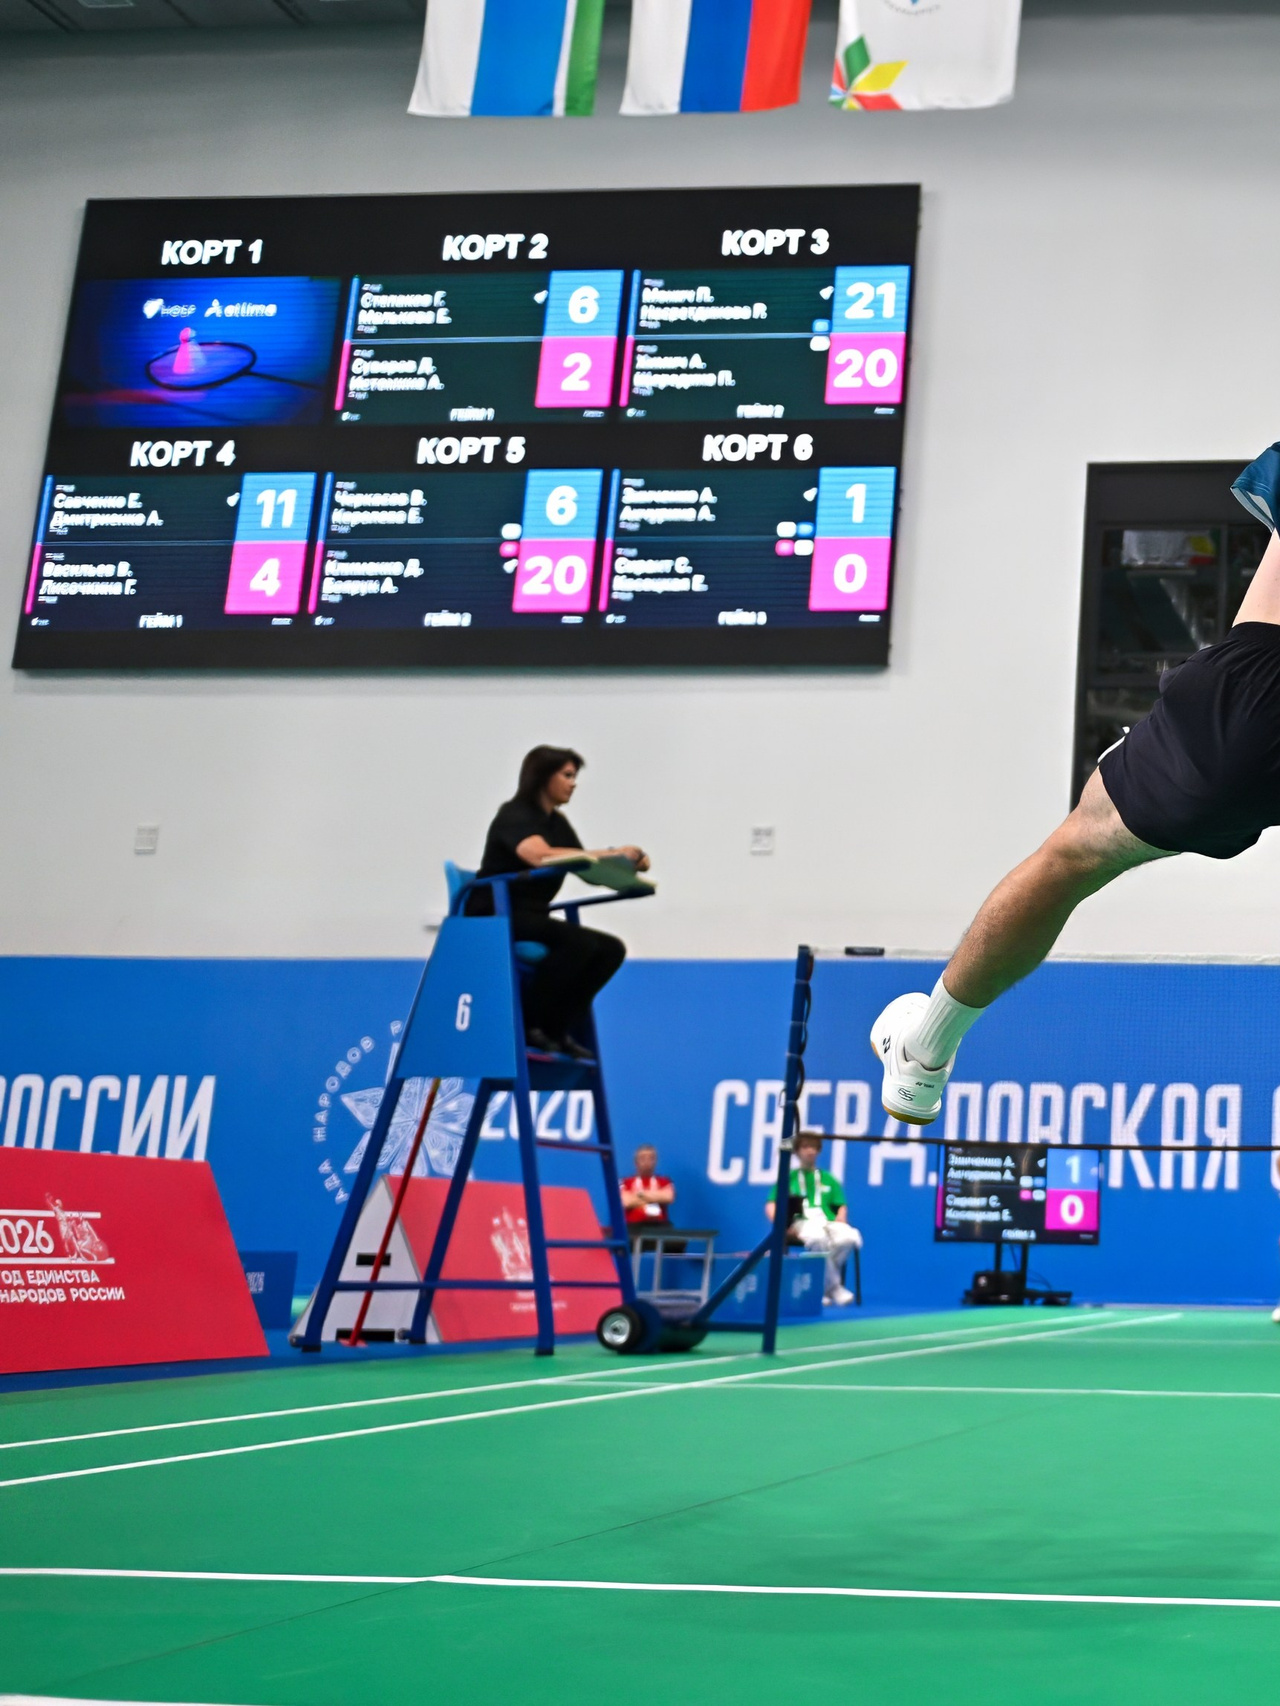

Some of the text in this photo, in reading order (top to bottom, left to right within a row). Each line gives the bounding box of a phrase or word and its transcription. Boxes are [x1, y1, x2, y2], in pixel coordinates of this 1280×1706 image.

[162, 239, 263, 265] КОРТ 1
[443, 233, 549, 260] КОРТ 2
[722, 229, 829, 255] КОРТ 3
[568, 285, 599, 324] 6
[844, 281, 897, 320] 21
[560, 352, 592, 392] 2
[832, 348, 899, 388] 20
[131, 440, 236, 467] КОРТ 4
[417, 437, 526, 464] КОРТ 5
[702, 434, 814, 461] КОРТ 6
[256, 489, 297, 528] 11
[545, 485, 578, 525] 6
[845, 483, 867, 523] 1
[249, 558, 281, 597] 4
[521, 555, 588, 596] 20
[833, 553, 868, 594] 0
[455, 993, 472, 1031] 6
[0, 1073, 216, 1162] ОССИИ
[1065, 1154, 1081, 1184] 1
[1060, 1194, 1084, 1225] 0
[0, 1219, 54, 1255] 026
[0, 1269, 100, 1286] ОД ЕДИНСТВА
[0, 1286, 125, 1304] НАРОДОВ РОССИИ
